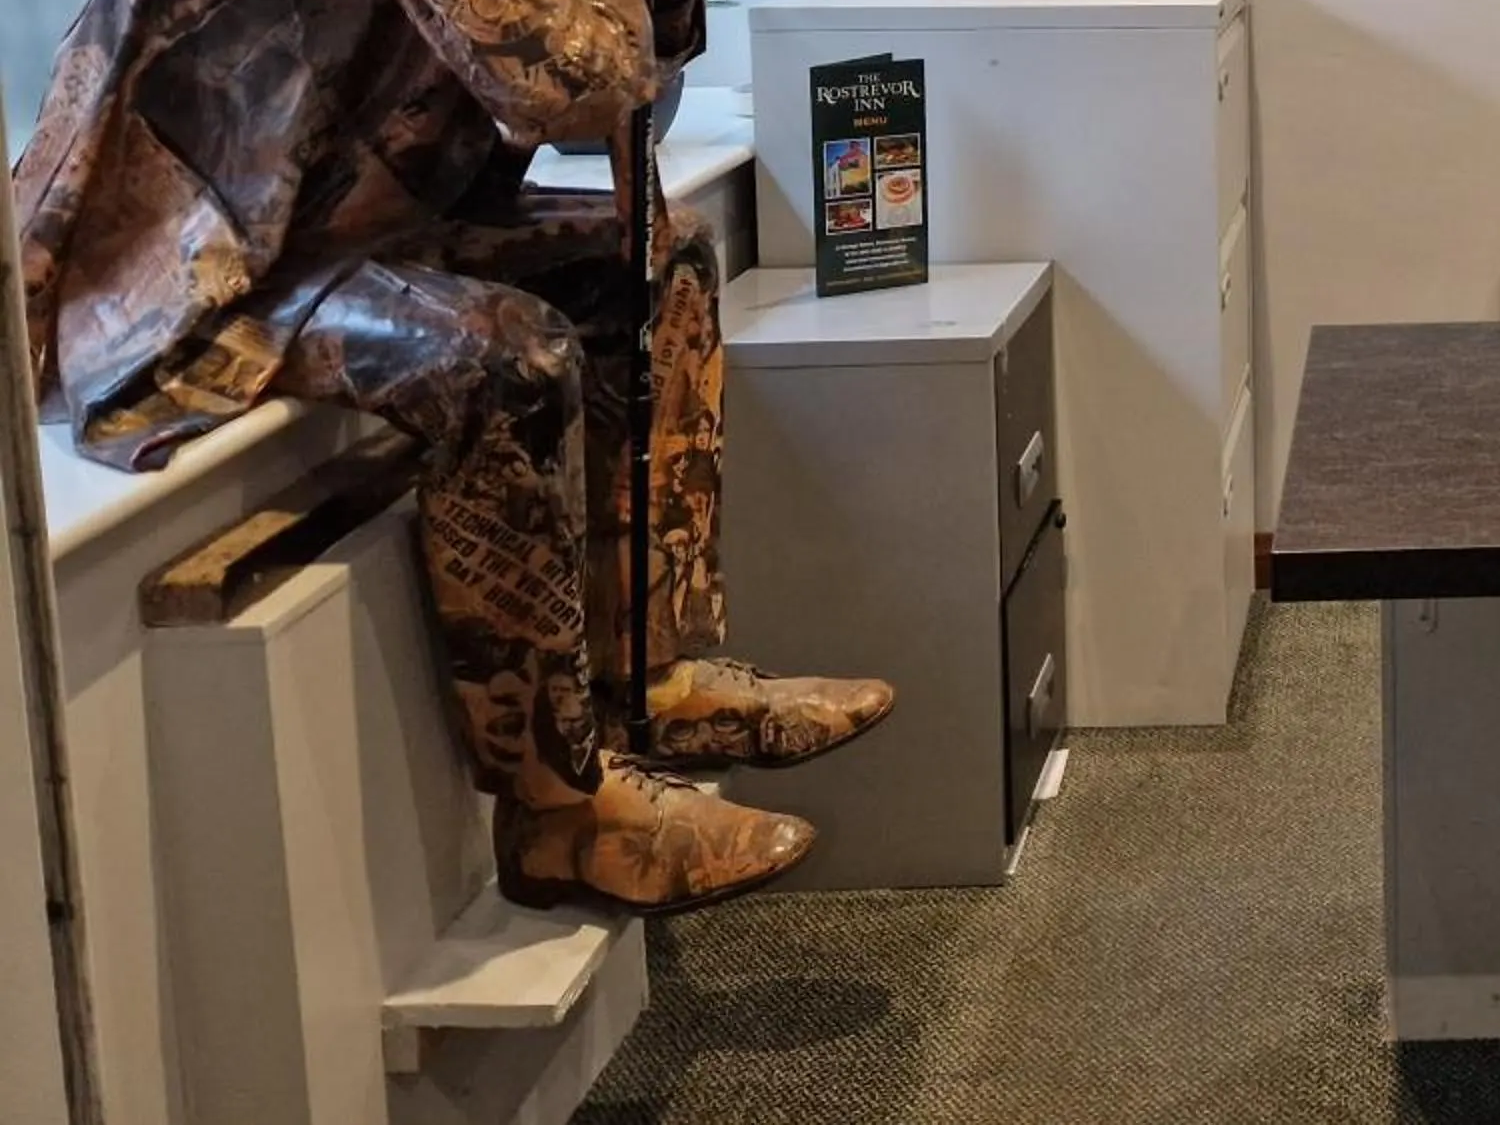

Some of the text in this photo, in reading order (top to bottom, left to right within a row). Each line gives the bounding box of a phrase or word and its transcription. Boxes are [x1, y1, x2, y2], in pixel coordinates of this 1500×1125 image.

[857, 74, 881, 84] THE
[816, 80, 920, 104] ROSTREVOR
[853, 97, 886, 112] INN
[478, 547, 521, 578] THE
